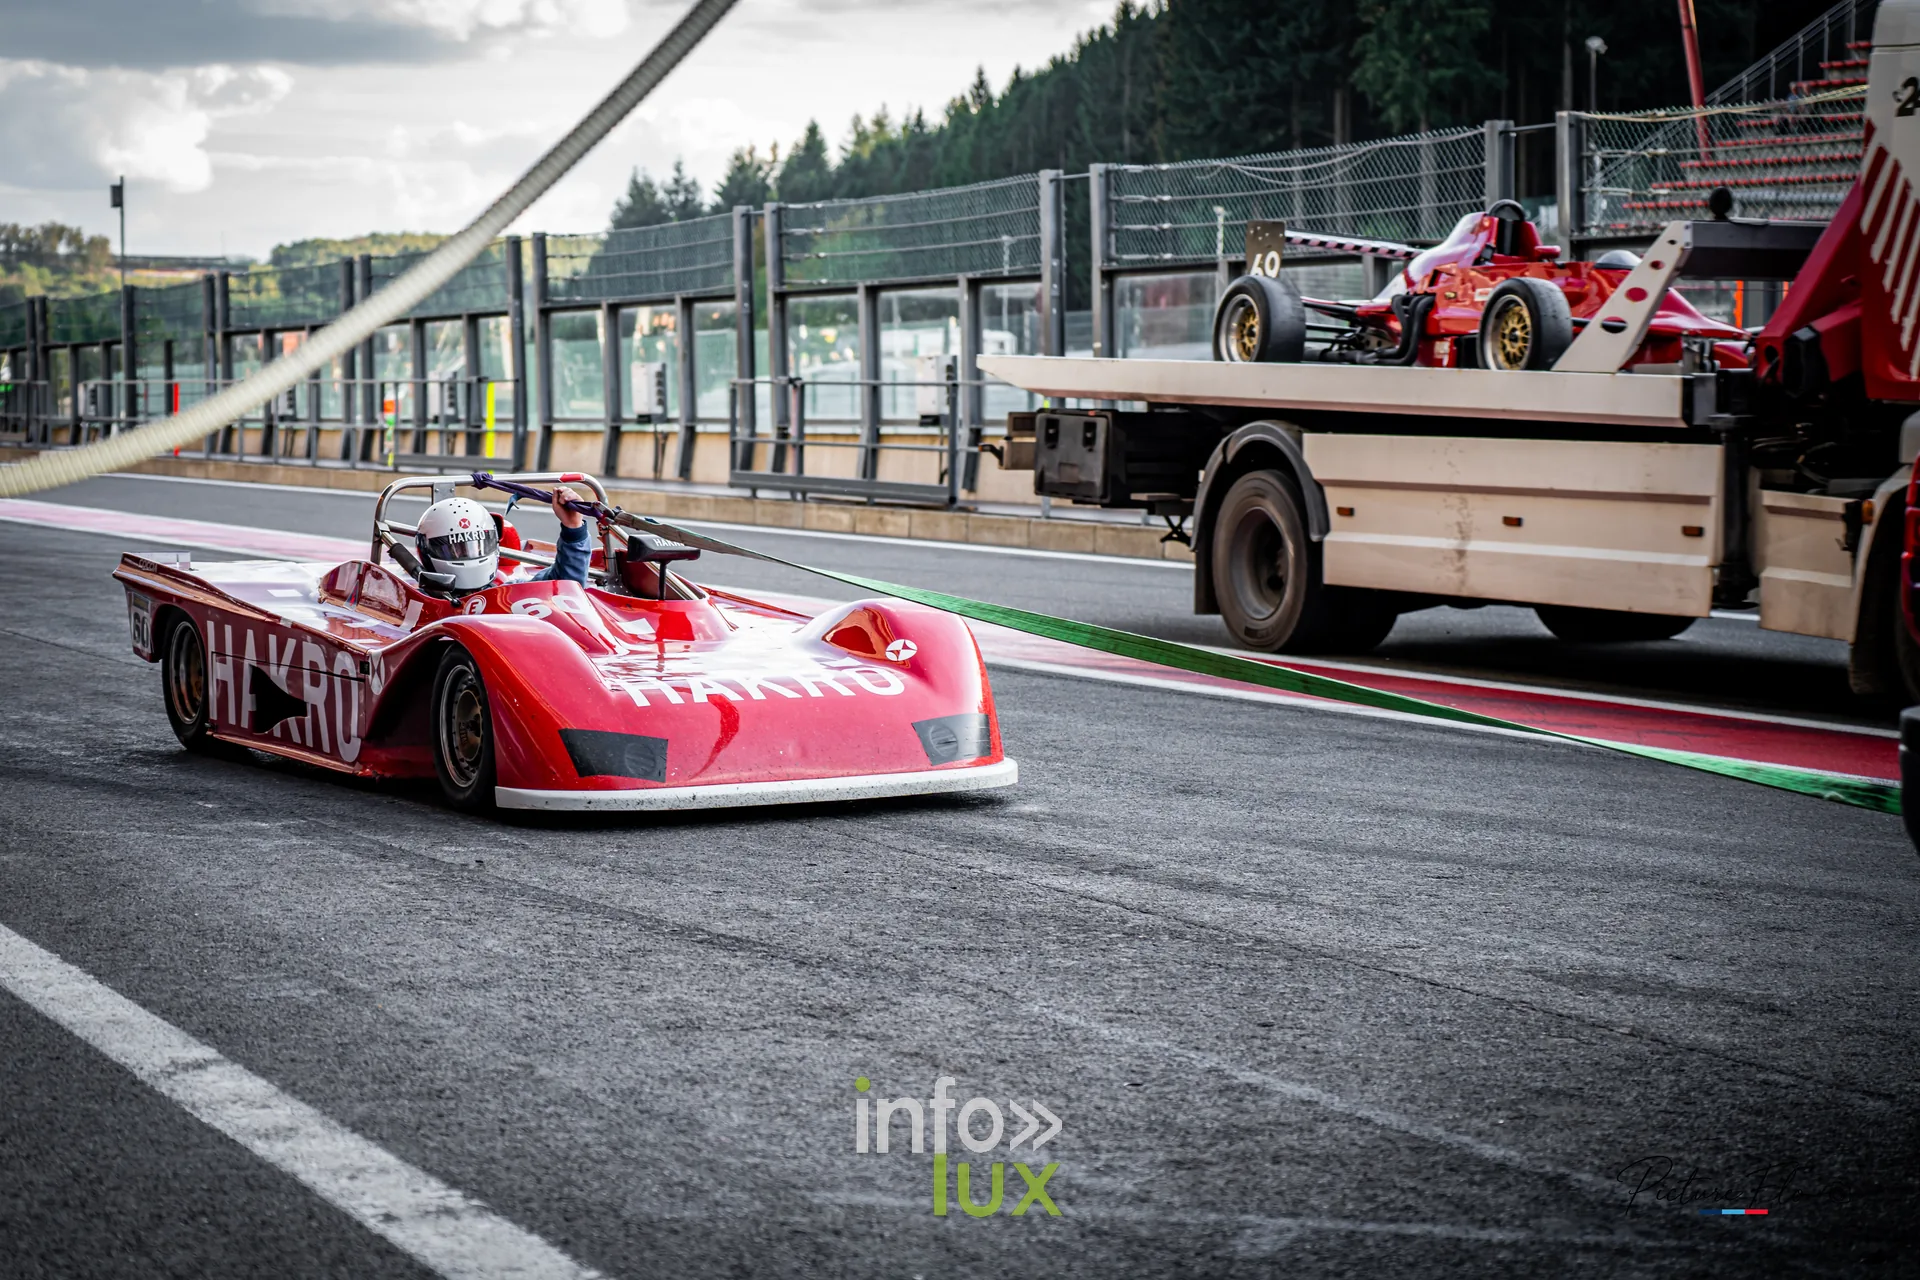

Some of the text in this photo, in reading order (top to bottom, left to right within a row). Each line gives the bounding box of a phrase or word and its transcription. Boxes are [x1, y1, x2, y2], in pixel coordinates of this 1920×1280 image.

[448, 530, 486, 544] HAKRO
[510, 595, 594, 619] 60
[132, 611, 150, 649] 60
[207, 620, 362, 763] HAKRO
